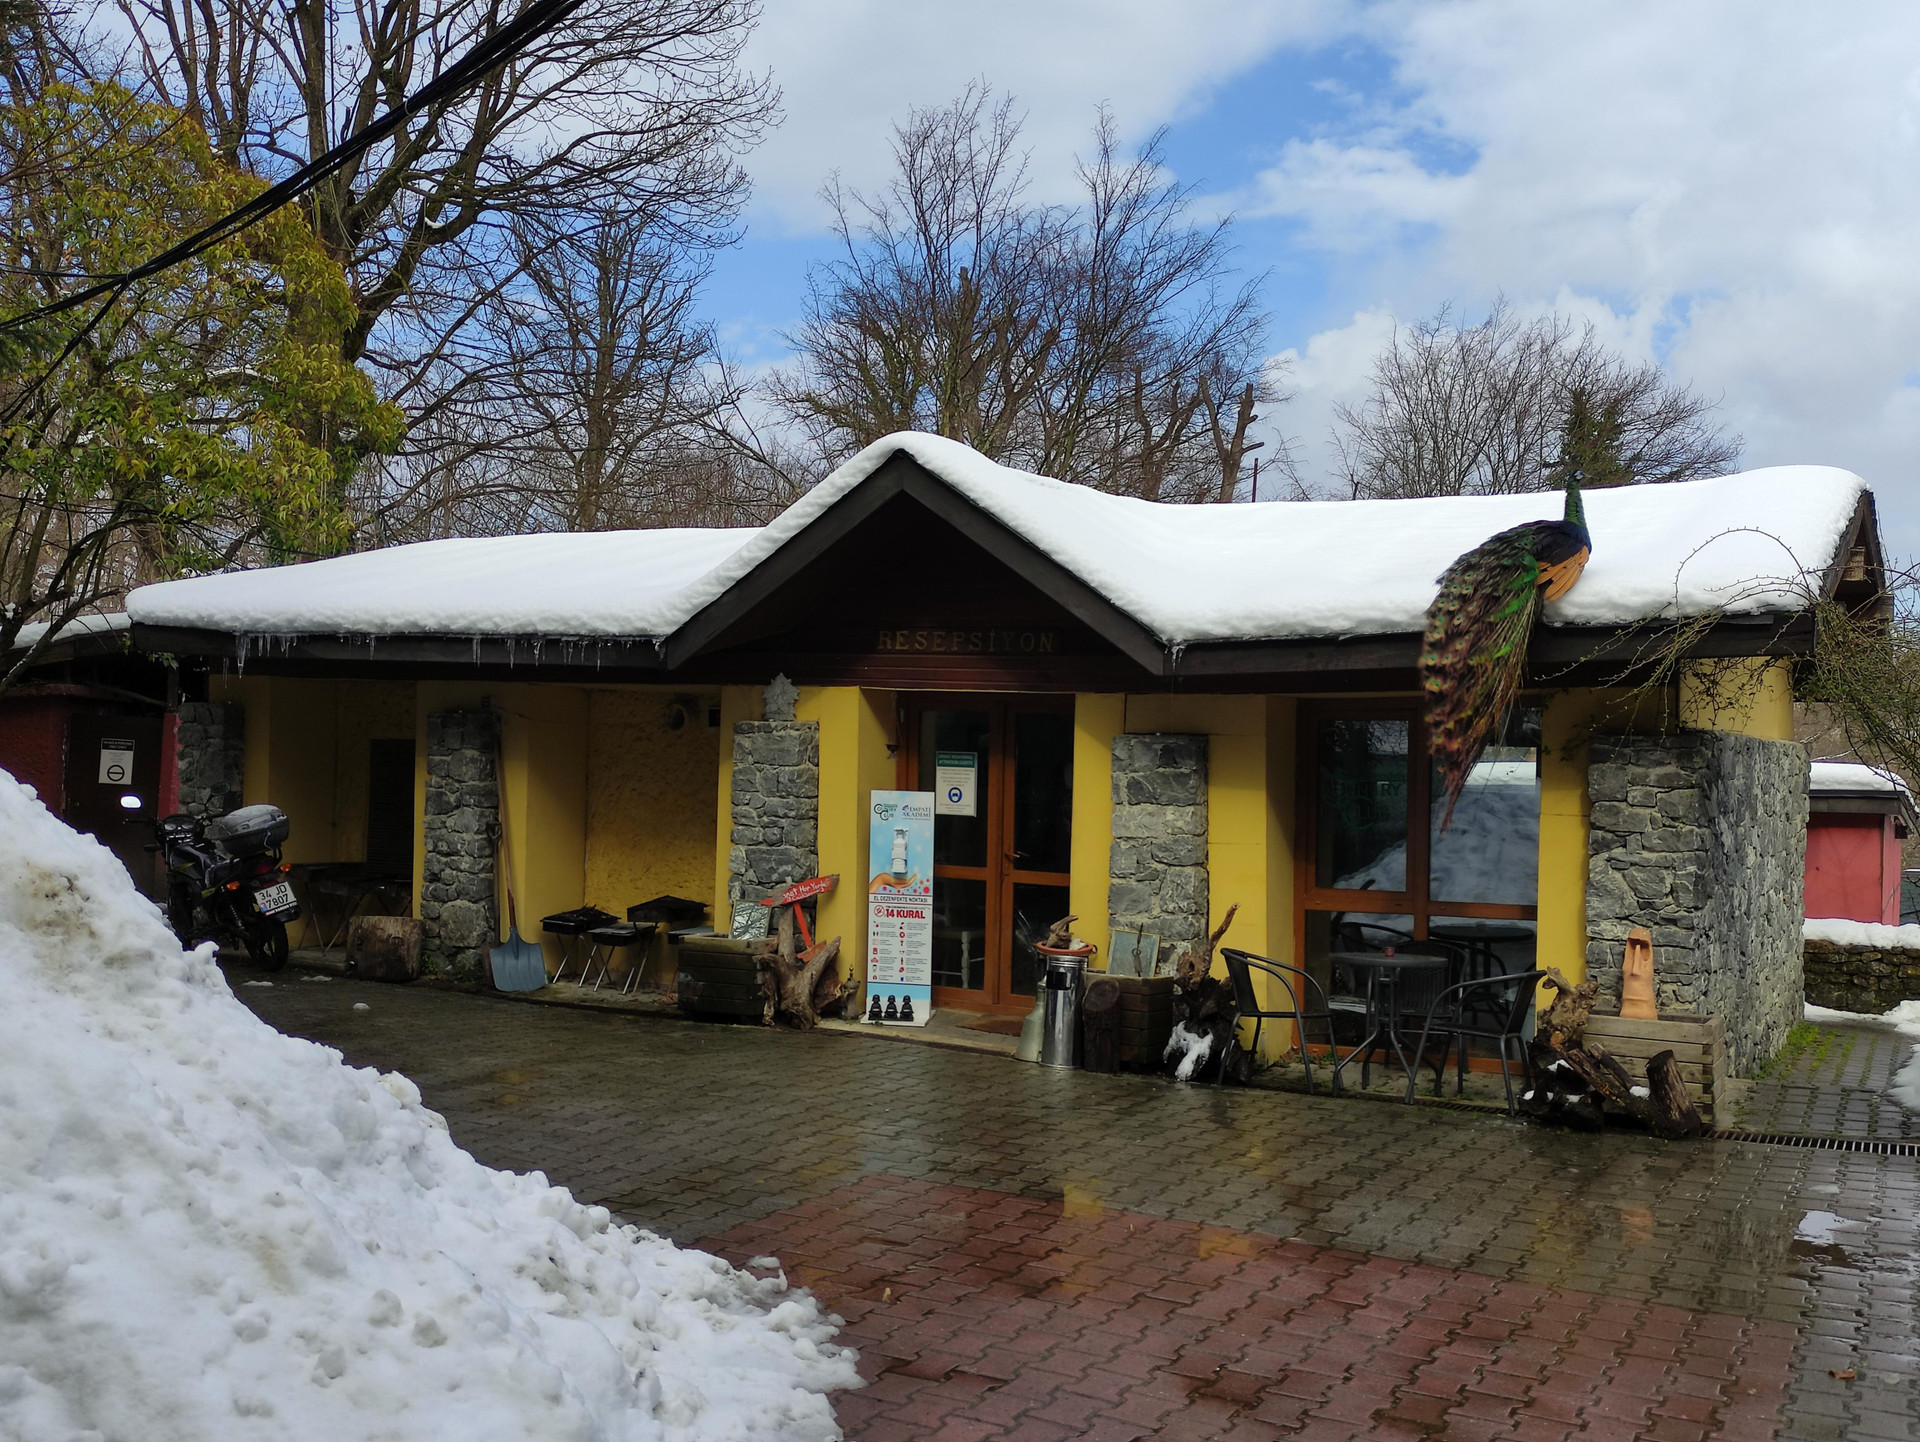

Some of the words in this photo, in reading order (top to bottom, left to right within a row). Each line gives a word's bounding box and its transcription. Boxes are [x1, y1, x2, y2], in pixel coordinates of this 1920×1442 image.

[876, 629, 1054, 653] RESEPSİYON
[258, 890, 272, 901] 34
[275, 884, 287, 895] JD
[266, 894, 288, 908] 7807
[885, 908, 895, 918] 14
[896, 908, 926, 919] KURAL
